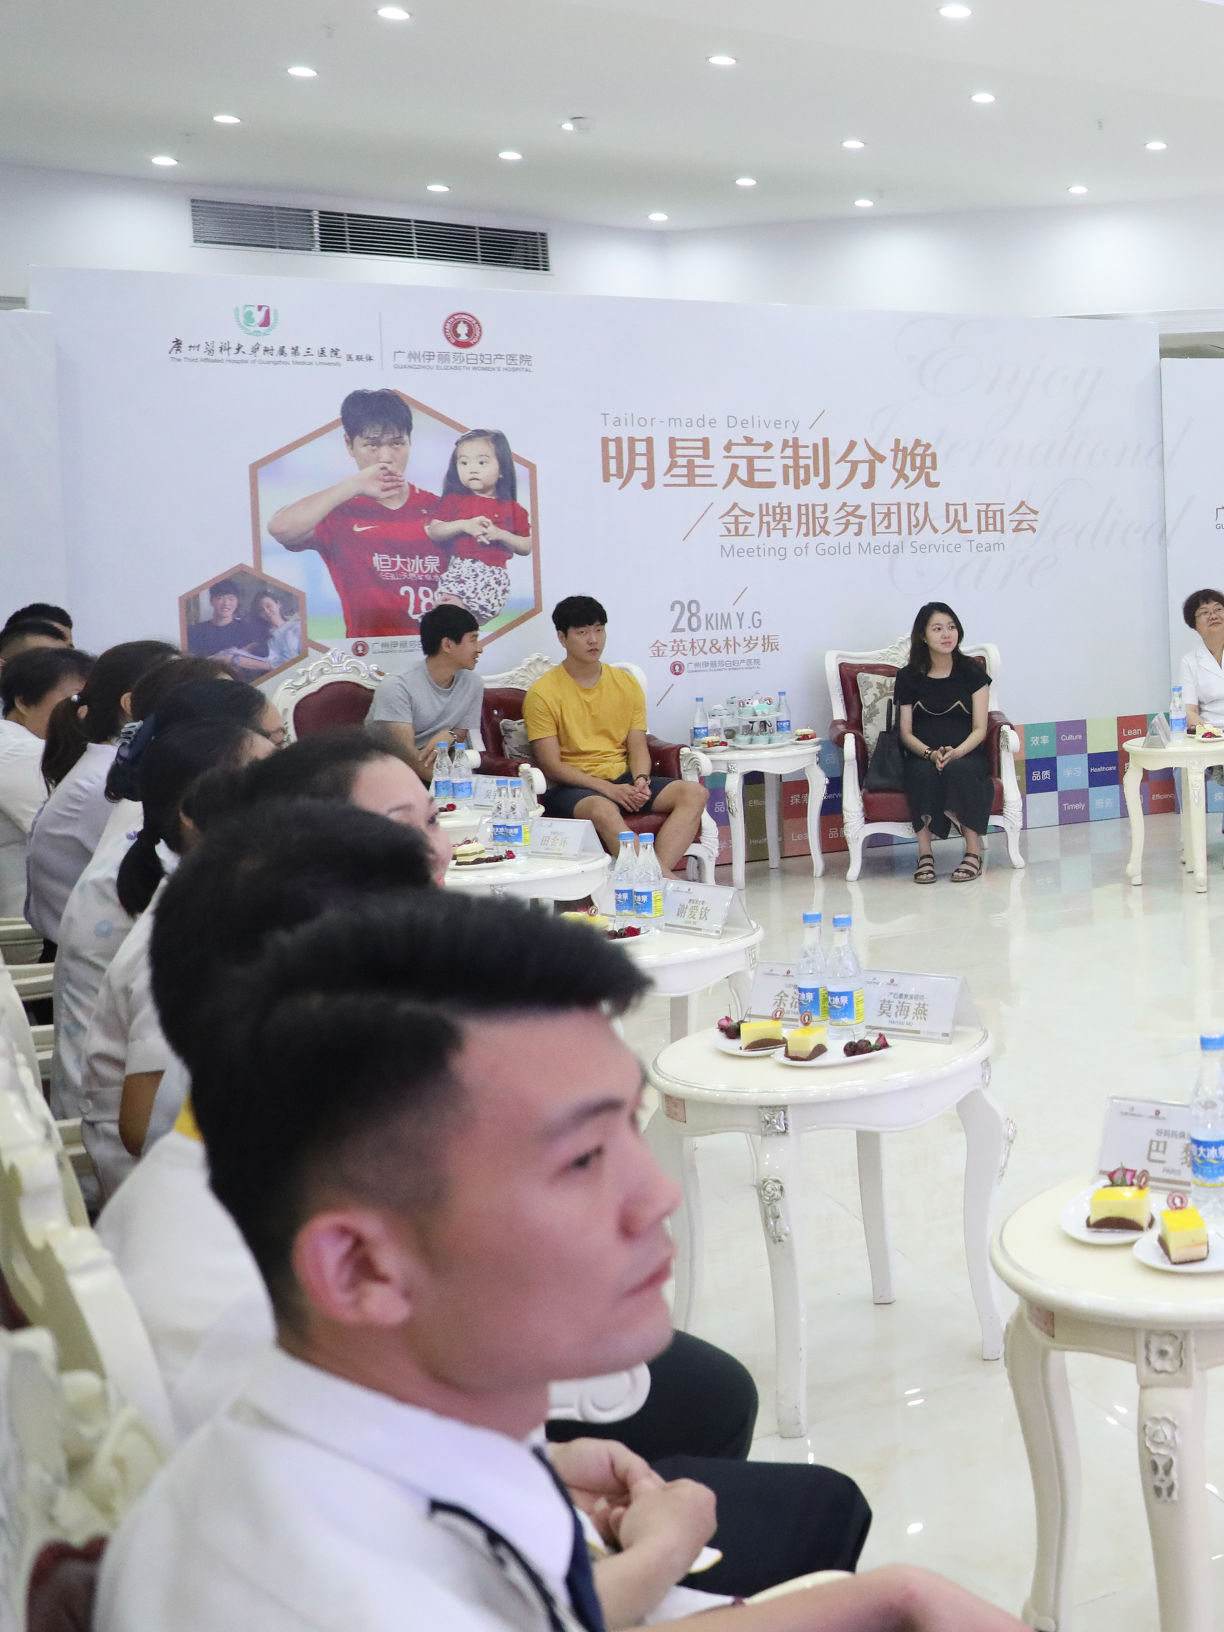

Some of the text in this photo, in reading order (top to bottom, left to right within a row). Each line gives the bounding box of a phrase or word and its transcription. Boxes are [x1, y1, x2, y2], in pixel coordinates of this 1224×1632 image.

[393, 350, 533, 367] 广州伊丽莎白妇产医院
[895, 317, 1104, 434] Enjoy
[601, 412, 800, 433] Tailor-made Delivery
[601, 435, 941, 491] 明星定制分娩
[718, 500, 1040, 538] 金牌服务团队见面会
[720, 538, 1005, 561] Meeting of Gold Medal Service Team
[373, 552, 440, 574] 恒大冰泉
[399, 585, 434, 623] 28
[670, 599, 702, 633] 28
[705, 611, 733, 631] KIM
[649, 634, 780, 658] 金英权&朴岁振
[1030, 735, 1050, 746] 效率
[1060, 733, 1083, 742] Culture
[1122, 727, 1142, 737] Lean
[1031, 769, 1051, 781] 品质
[1090, 765, 1117, 773] Healthcare
[1063, 801, 1086, 812] Timely
[877, 997, 929, 1021] 莫海燕
